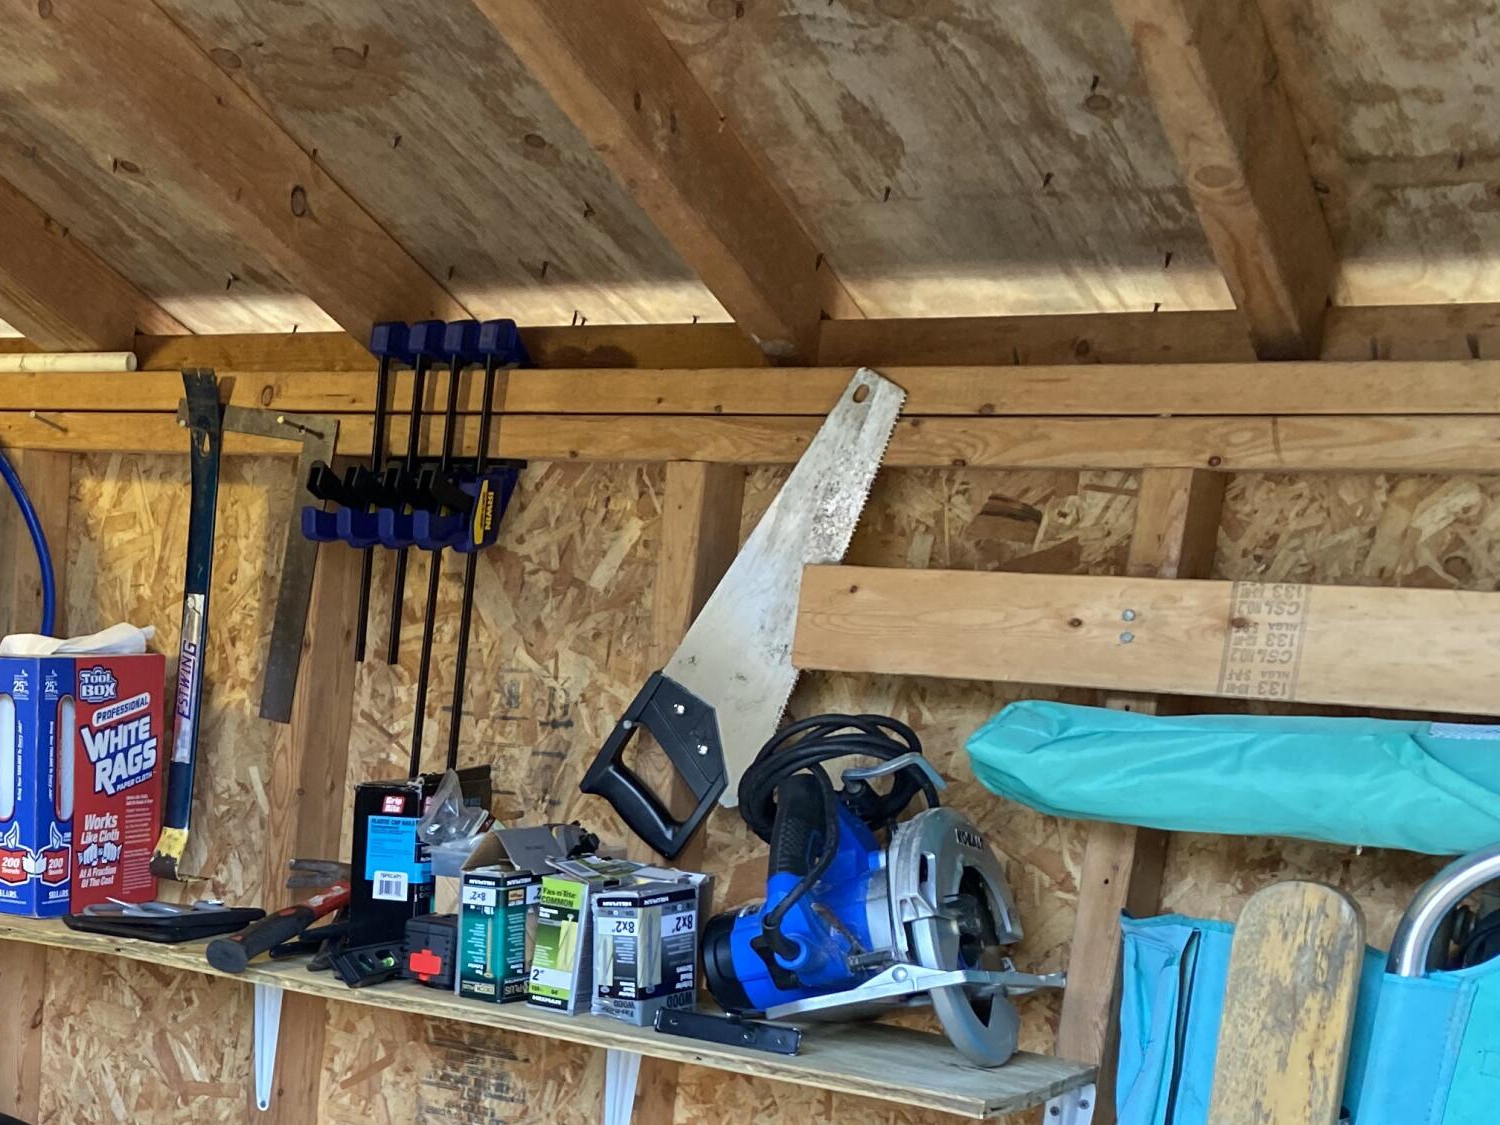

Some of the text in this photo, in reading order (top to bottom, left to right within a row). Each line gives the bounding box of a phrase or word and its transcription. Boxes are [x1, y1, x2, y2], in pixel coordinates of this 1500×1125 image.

[484, 491, 495, 531] IRWIN
[1265, 633, 1295, 647] 133
[81, 673, 113, 683] TOOL
[177, 640, 197, 720] ESTWING
[81, 682, 116, 697] BOX
[1258, 681, 1286, 696] 133
[96, 696, 149, 724] PROFESSIONAL
[80, 715, 151, 762] WHITE
[95, 737, 157, 795] RAGS
[116, 778, 135, 792] PAPER
[84, 812, 118, 831] Works
[80, 828, 120, 845] Like Cloth
[1, 857, 20, 868] 200
[48, 858, 64, 869] 200
